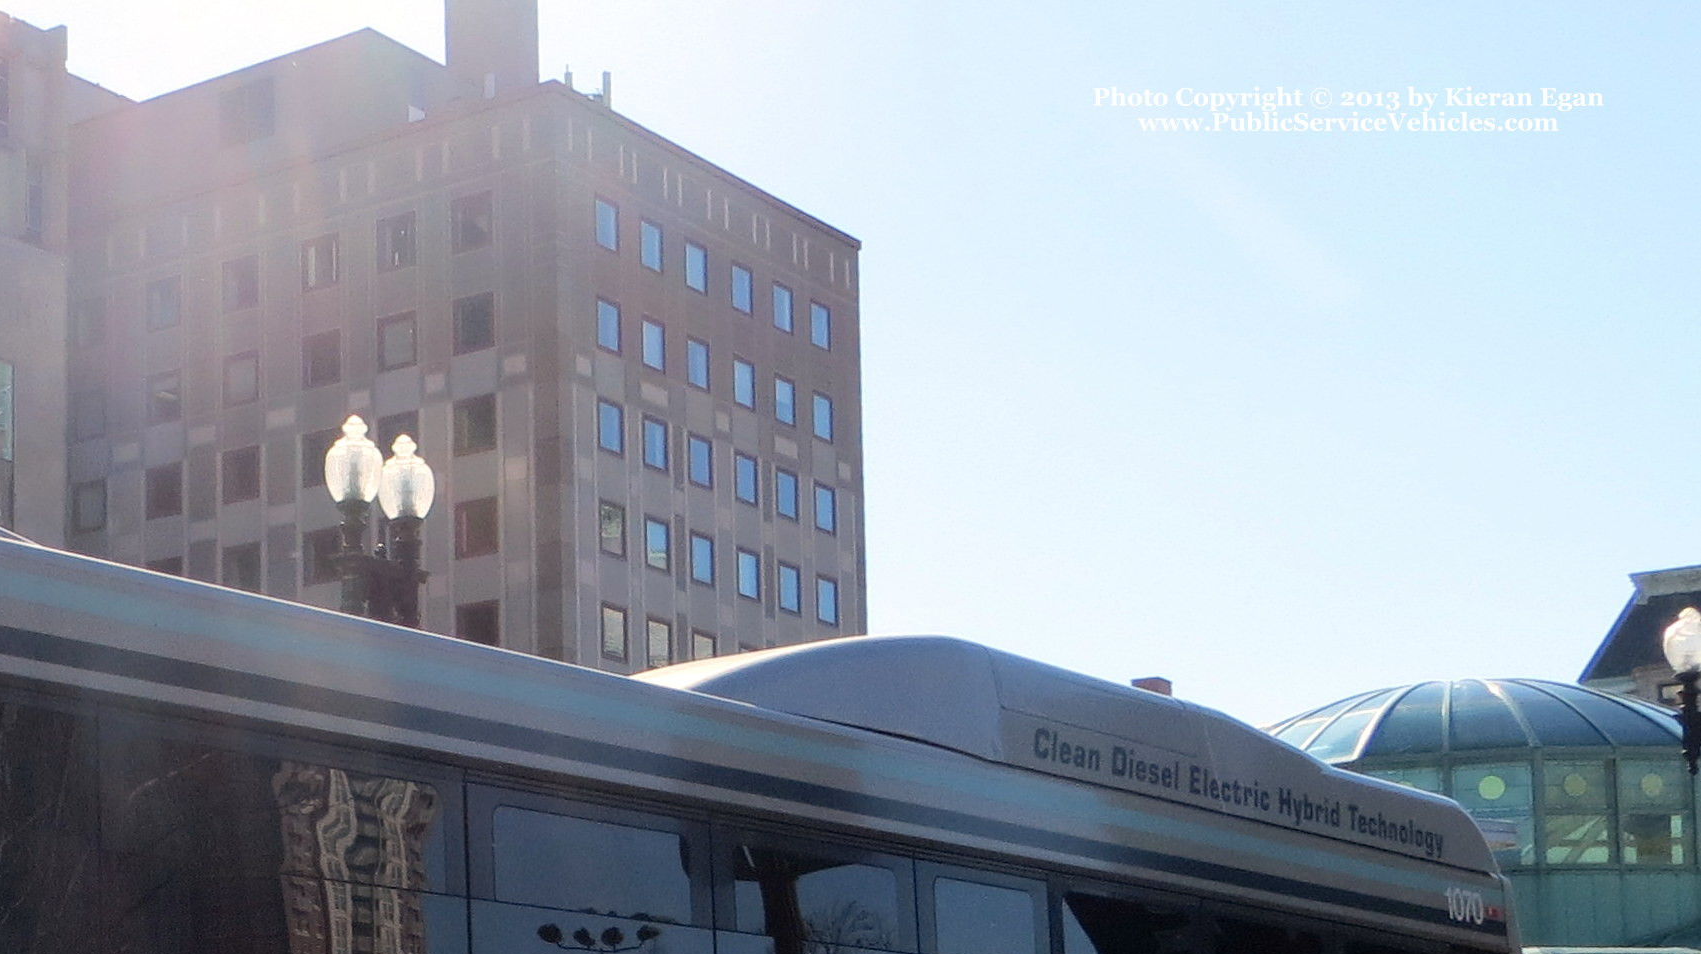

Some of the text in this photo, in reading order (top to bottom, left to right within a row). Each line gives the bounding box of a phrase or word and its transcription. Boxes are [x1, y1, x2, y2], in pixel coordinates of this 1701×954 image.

[1033, 727, 1445, 859] Clean Diesel Electric Hybrid Technology
[1443, 886, 1485, 926] 1070
